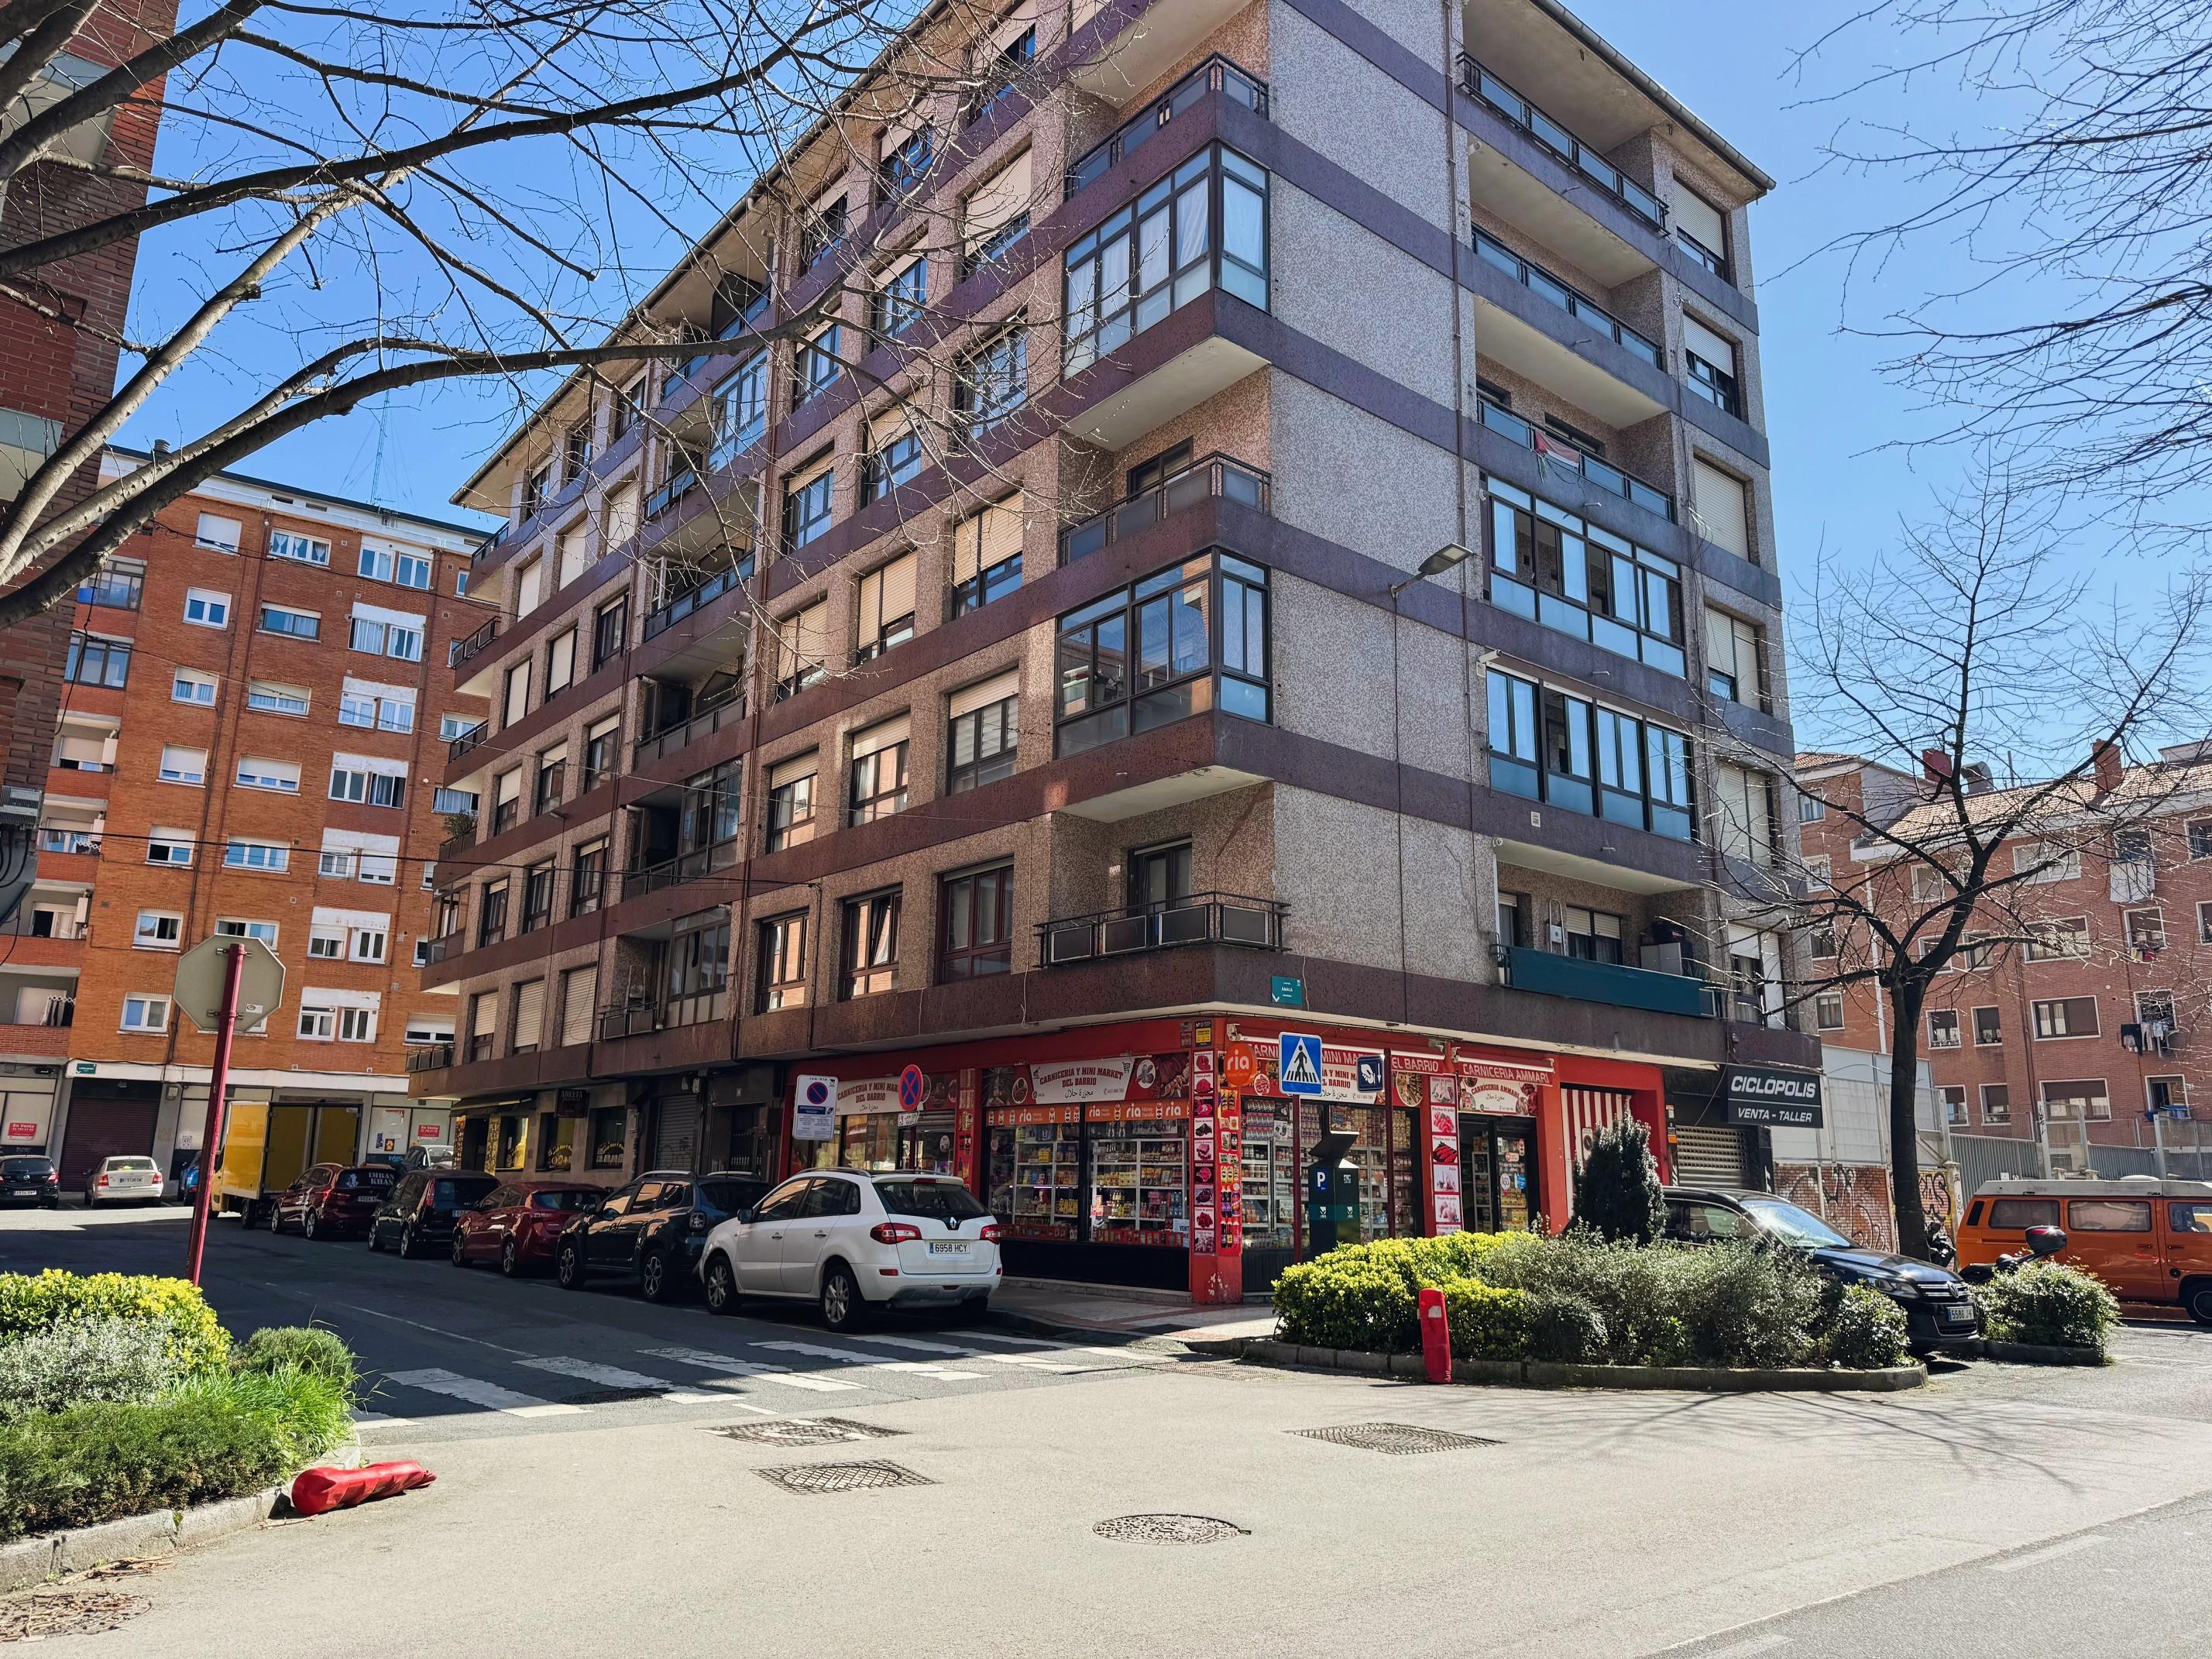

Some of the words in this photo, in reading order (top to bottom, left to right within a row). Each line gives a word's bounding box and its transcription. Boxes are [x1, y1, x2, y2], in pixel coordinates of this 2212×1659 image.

[1228, 1049, 1249, 1070] ria
[1392, 1057, 1403, 1069] EL
[1404, 1058, 1438, 1072] BARRIO
[1097, 1068, 1123, 1080] MARKET
[1463, 1063, 1513, 1080] CARNICERIA
[1516, 1070, 1549, 1083] AMMARI
[887, 1083, 898, 1092] MAR
[1063, 1078, 1073, 1087] DEL
[1075, 1077, 1097, 1086] BARRIO
[1329, 1080, 1351, 1089] BARRIO
[1731, 1076, 1815, 1098] CICLÓPOLIS
[1500, 1085, 1520, 1098] AMMARI
[856, 1094, 866, 1103] DEL
[1089, 1105, 1100, 1117] ria
[1126, 1103, 1142, 1117] ria
[1166, 1101, 1181, 1115] ria
[1019, 1109, 1032, 1122] ria
[1738, 1108, 1769, 1120] VENTA
[1779, 1111, 1812, 1122] TALLER
[1317, 1172, 1326, 1187] P
